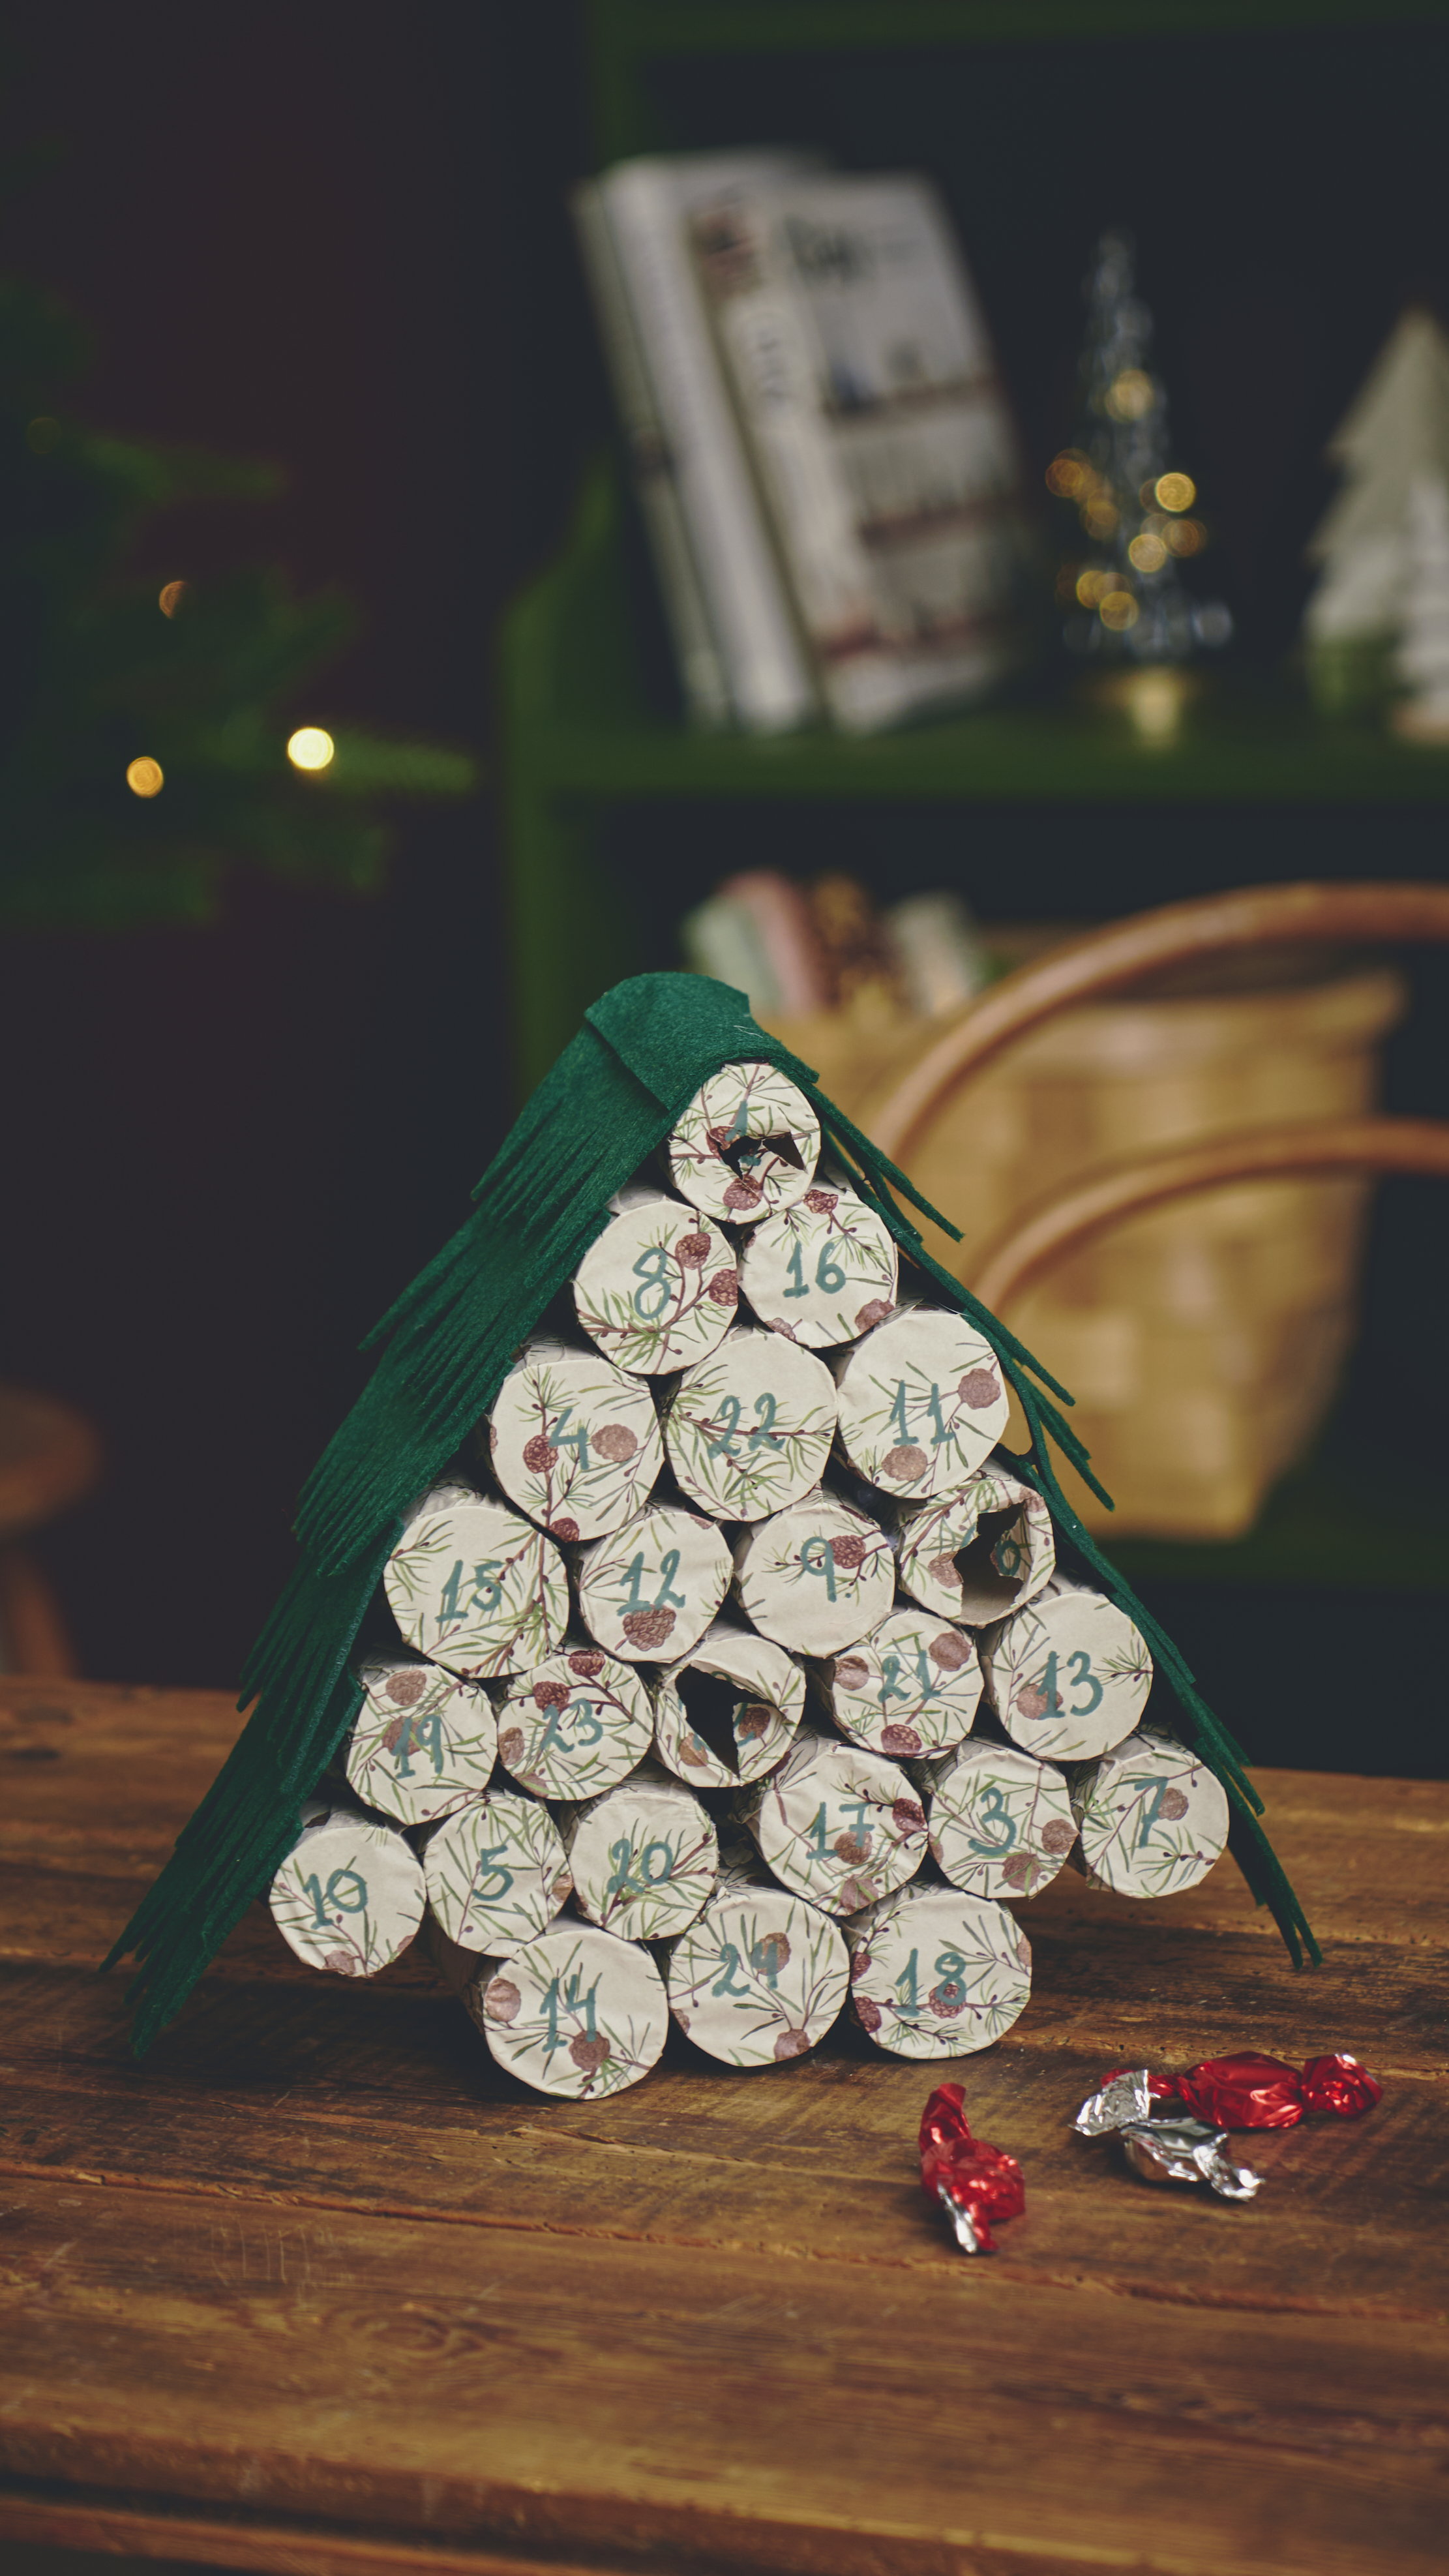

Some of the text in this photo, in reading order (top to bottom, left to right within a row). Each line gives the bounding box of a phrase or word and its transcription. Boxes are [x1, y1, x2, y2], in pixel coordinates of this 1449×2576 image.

[633, 1247, 671, 1321] 8
[783, 1240, 846, 1298] 16
[548, 1408, 590, 1471] 4
[708, 1393, 785, 1459] 22
[889, 1380, 956, 1445] 11
[435, 1560, 503, 1623] 15
[617, 1549, 685, 1616] 12
[878, 1650, 941, 1702] 21
[1036, 1651, 1103, 1720] 13
[392, 1714, 443, 1779] 19
[539, 1698, 604, 1754] 23
[806, 1802, 876, 1860] 17
[968, 1788, 1017, 1855] 3
[1133, 1777, 1169, 1848] 7
[473, 1837, 514, 1901] 5
[607, 1838, 674, 1893] 20
[303, 1868, 367, 1929] 10
[712, 1941, 779, 1997] 24
[895, 1949, 967, 2016] 18
[539, 1973, 599, 2052] 14
